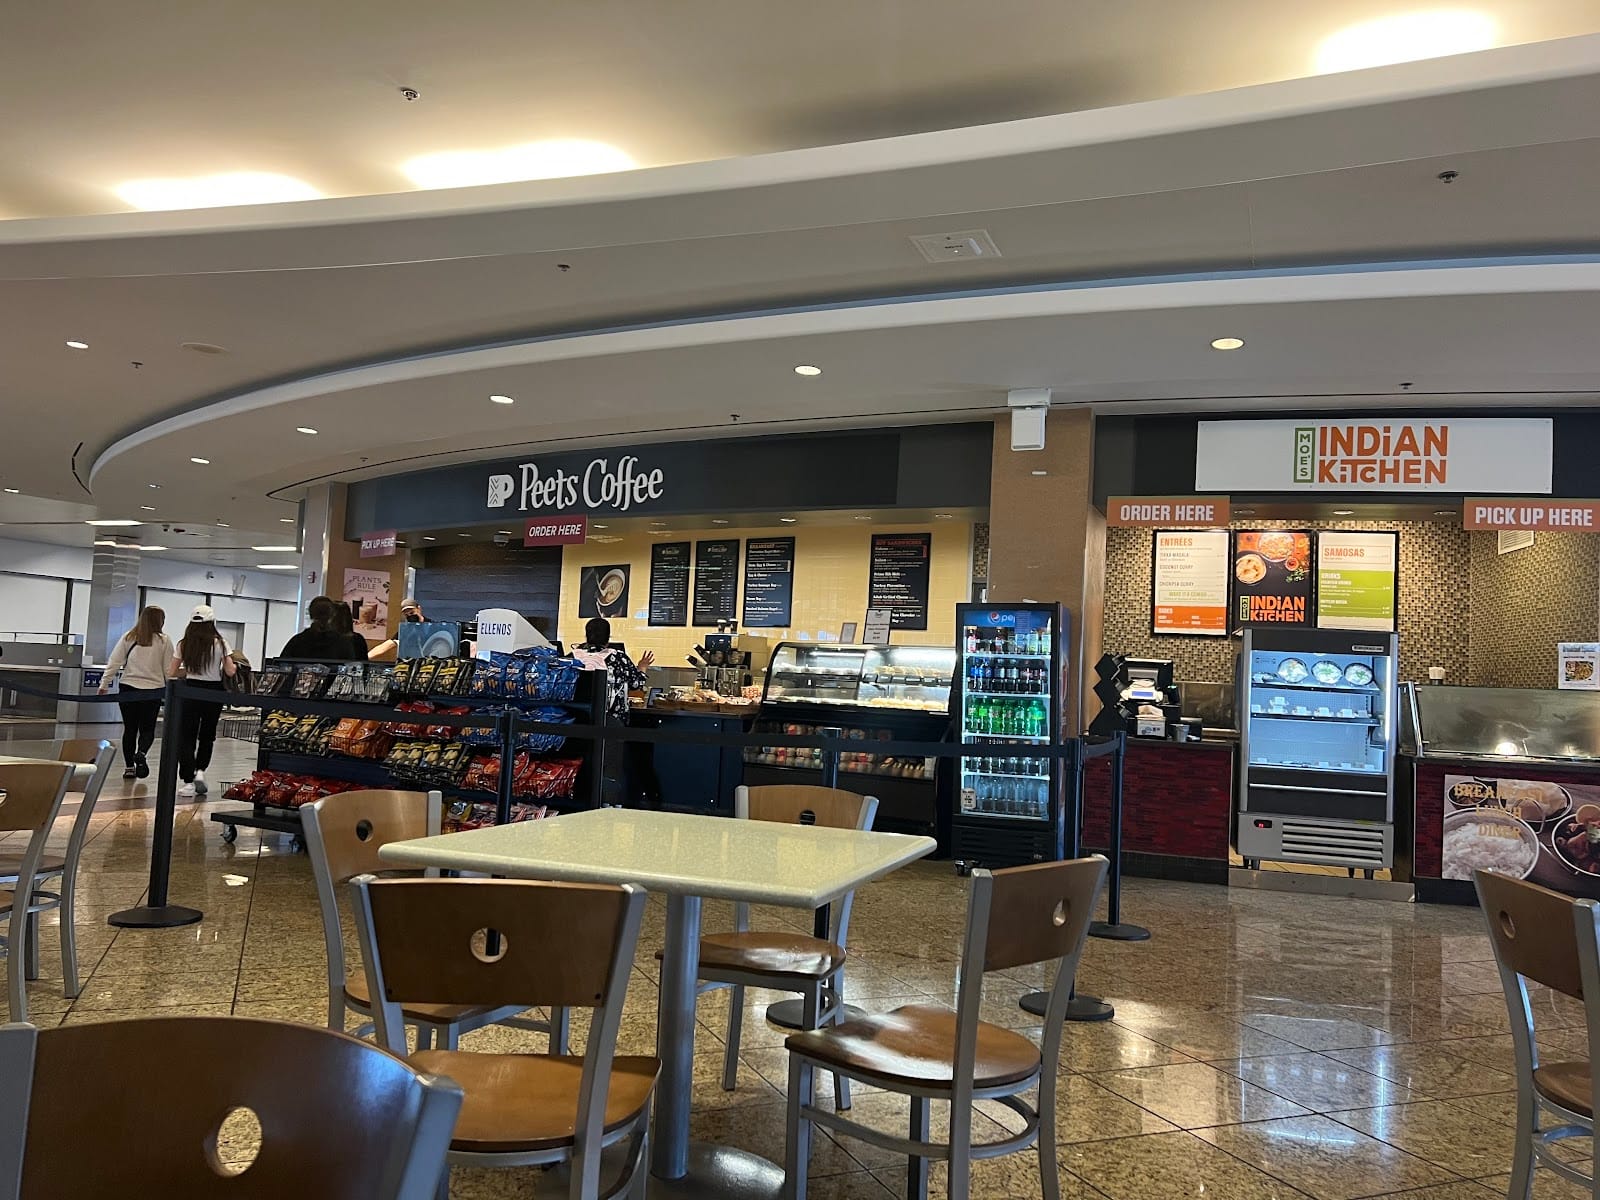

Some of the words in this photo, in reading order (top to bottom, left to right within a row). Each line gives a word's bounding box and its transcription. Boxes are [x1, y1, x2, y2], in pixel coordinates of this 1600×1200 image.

[583, 455, 664, 511] Coffee
[1120, 504, 1171, 521] ORDER
[1174, 504, 1215, 521] HERE
[1475, 506, 1517, 525] PICK
[1520, 507, 1544, 526] UP
[1548, 508, 1593, 527] HERE
[528, 525, 557, 538] ORDER
[558, 523, 583, 536] HERE
[1324, 547, 1365, 558] SAMOSAS
[352, 575, 382, 584] PLANTS
[357, 582, 377, 590] RULE
[480, 622, 512, 636] ELLENOS
